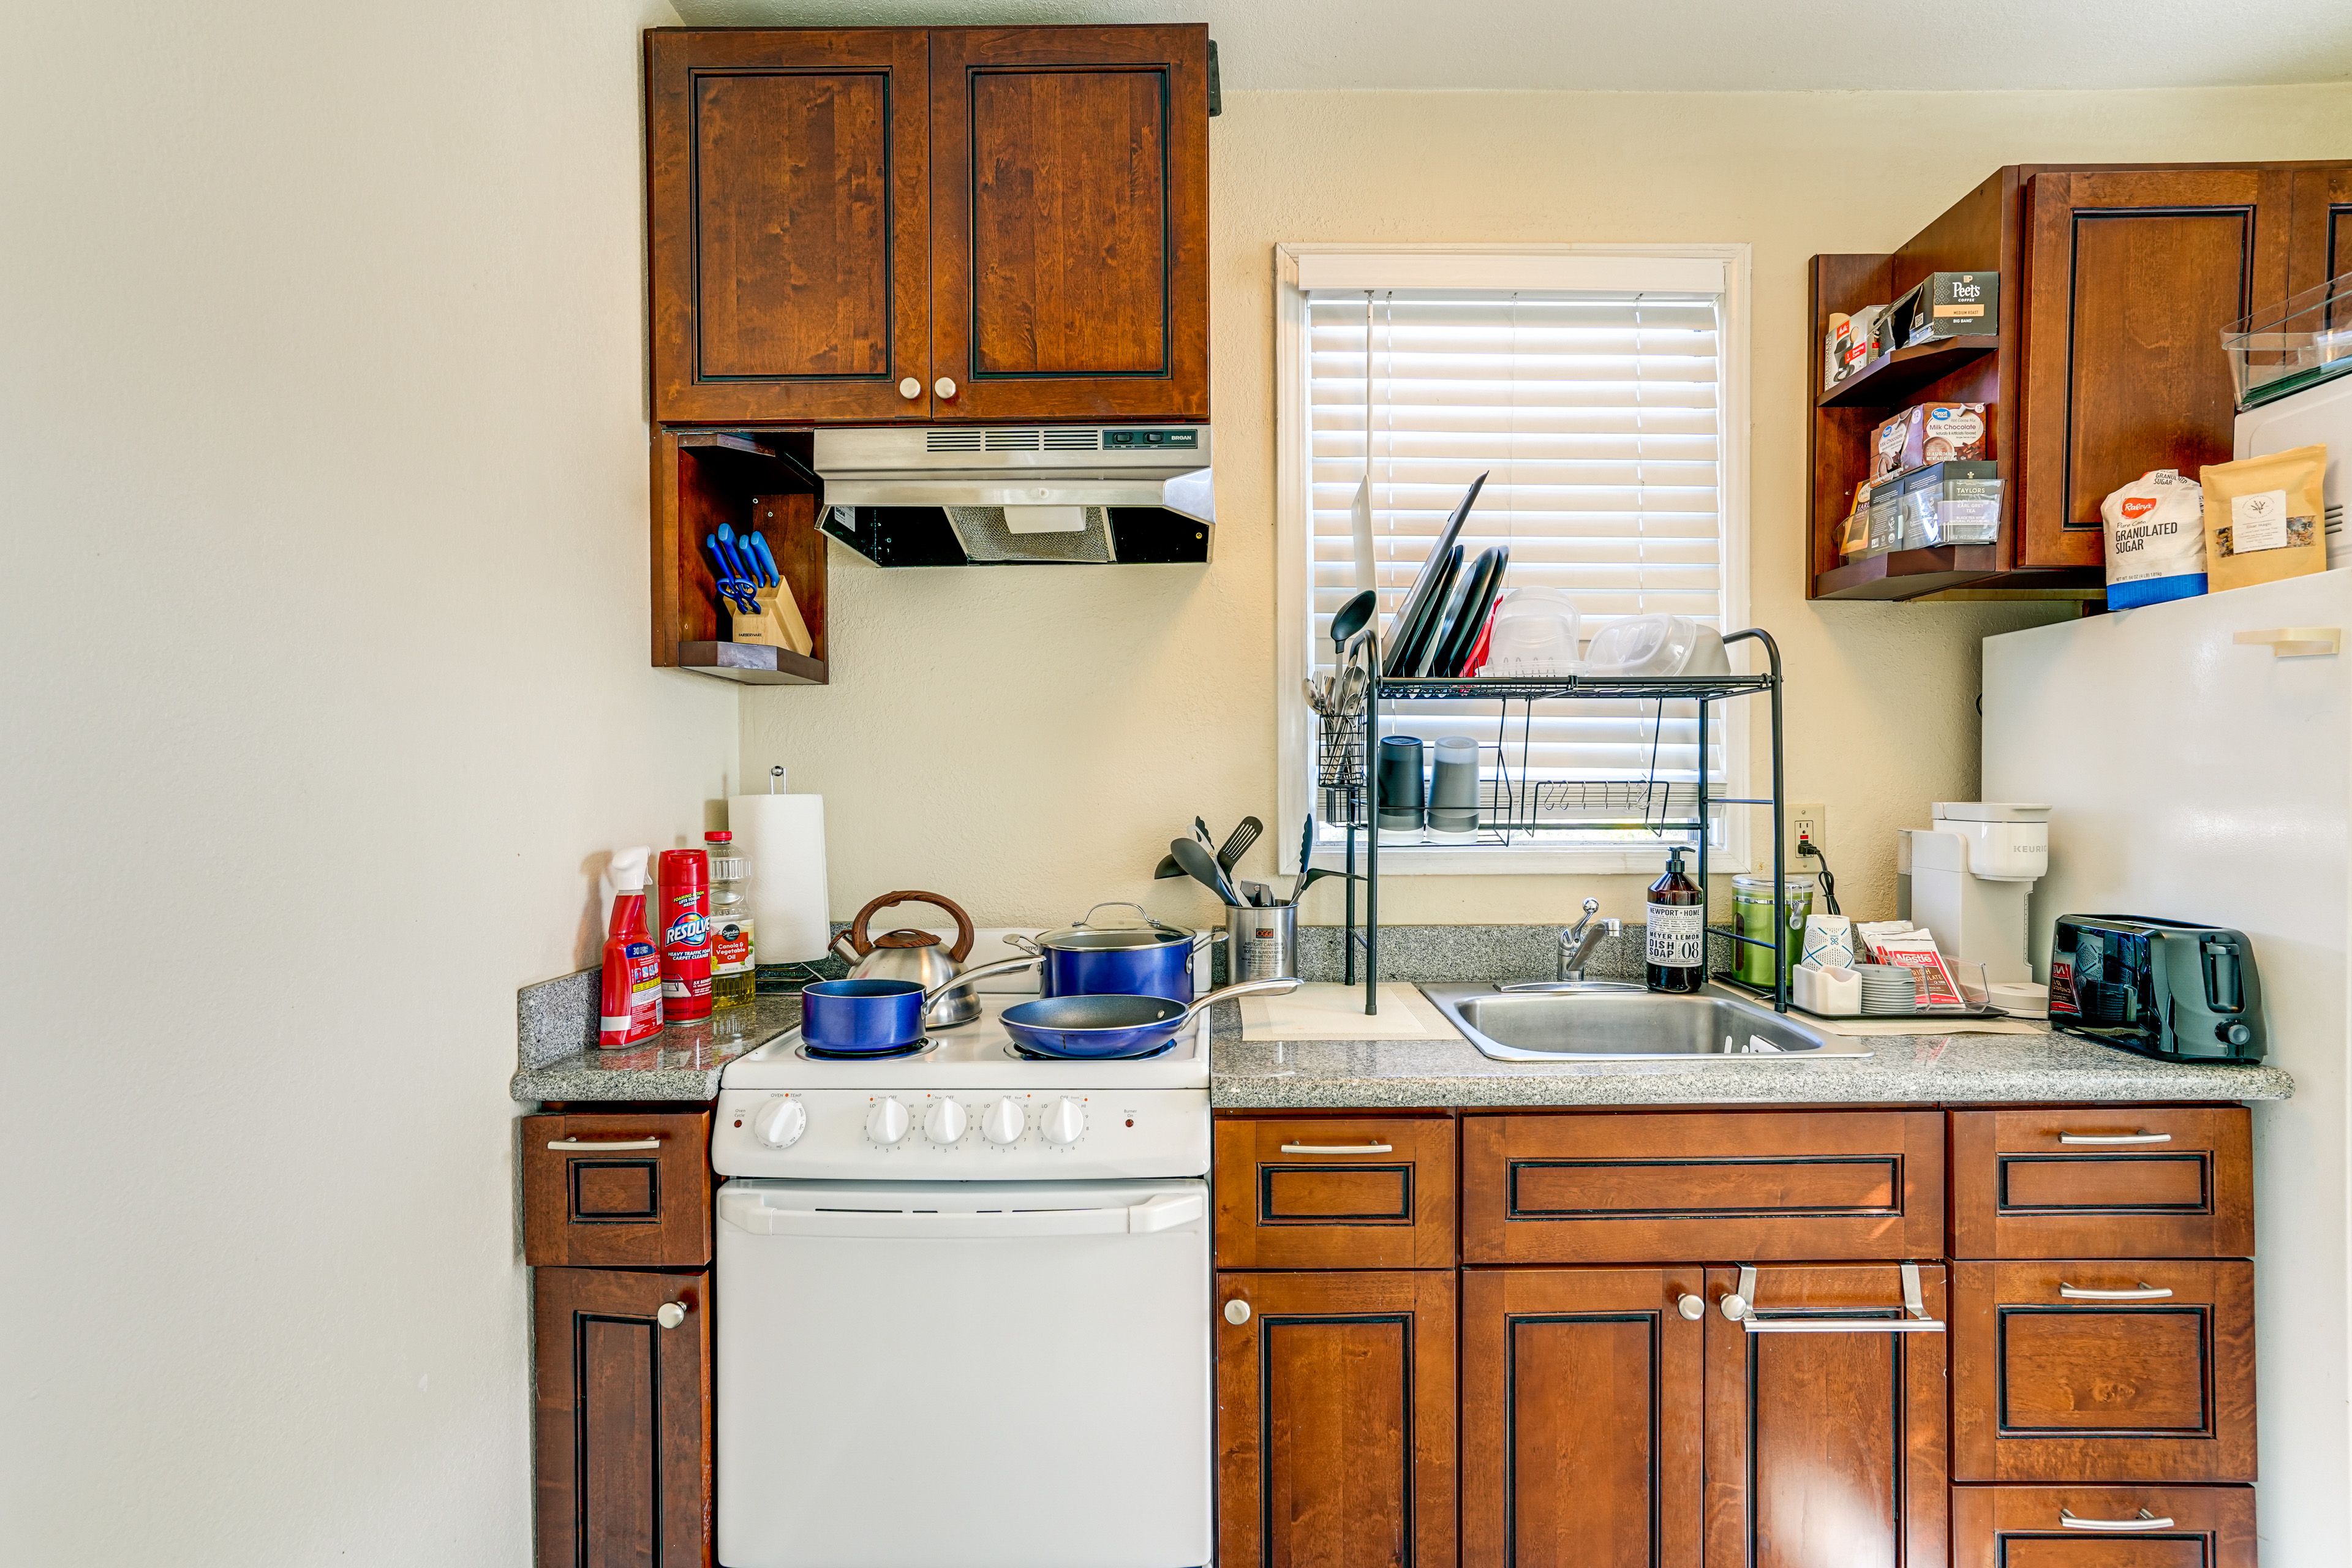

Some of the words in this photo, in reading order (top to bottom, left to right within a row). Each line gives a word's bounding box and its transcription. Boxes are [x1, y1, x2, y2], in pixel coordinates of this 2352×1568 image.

[1952, 282, 1981, 298] Peet's
[2116, 522, 2178, 542] GRANULATED
[2116, 538, 2144, 554] SUGAR
[673, 893, 692, 903] FOAMING
[1649, 907, 1679, 916] NEWPORT
[666, 916, 710, 945] RESOLVE
[1649, 931, 1672, 940] MEYER
[1649, 938, 1674, 950] DISH
[1681, 941, 1699, 959] 08
[716, 946, 745, 956] Vegetable
[1649, 947, 1674, 958] SOAP
